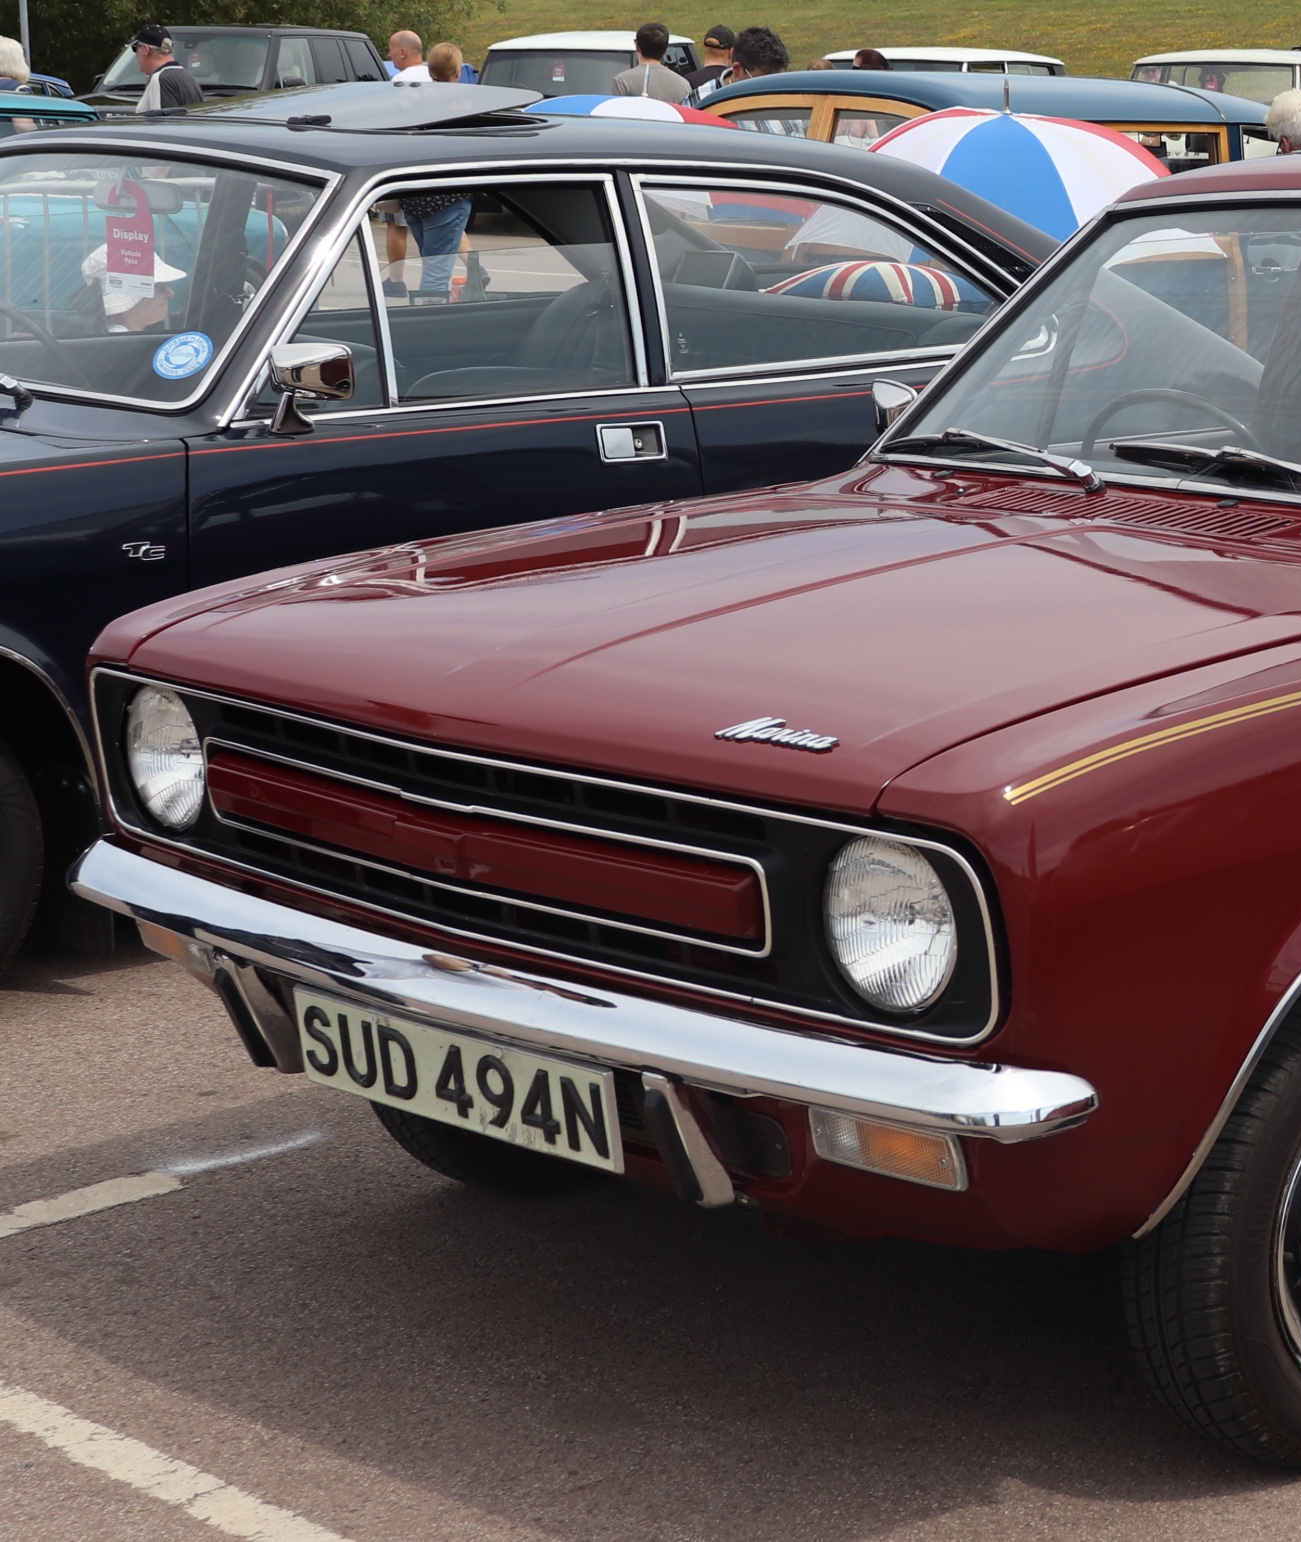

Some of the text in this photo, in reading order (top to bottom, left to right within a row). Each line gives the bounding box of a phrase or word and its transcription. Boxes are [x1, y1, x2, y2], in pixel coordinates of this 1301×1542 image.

[113, 228, 149, 243] Display
[120, 249, 141, 258] Vehicle
[124, 257, 138, 265] Pass
[122, 541, 166, 561] TC
[714, 716, 840, 750] Marina
[303, 1005, 610, 1160] SUD 494N
